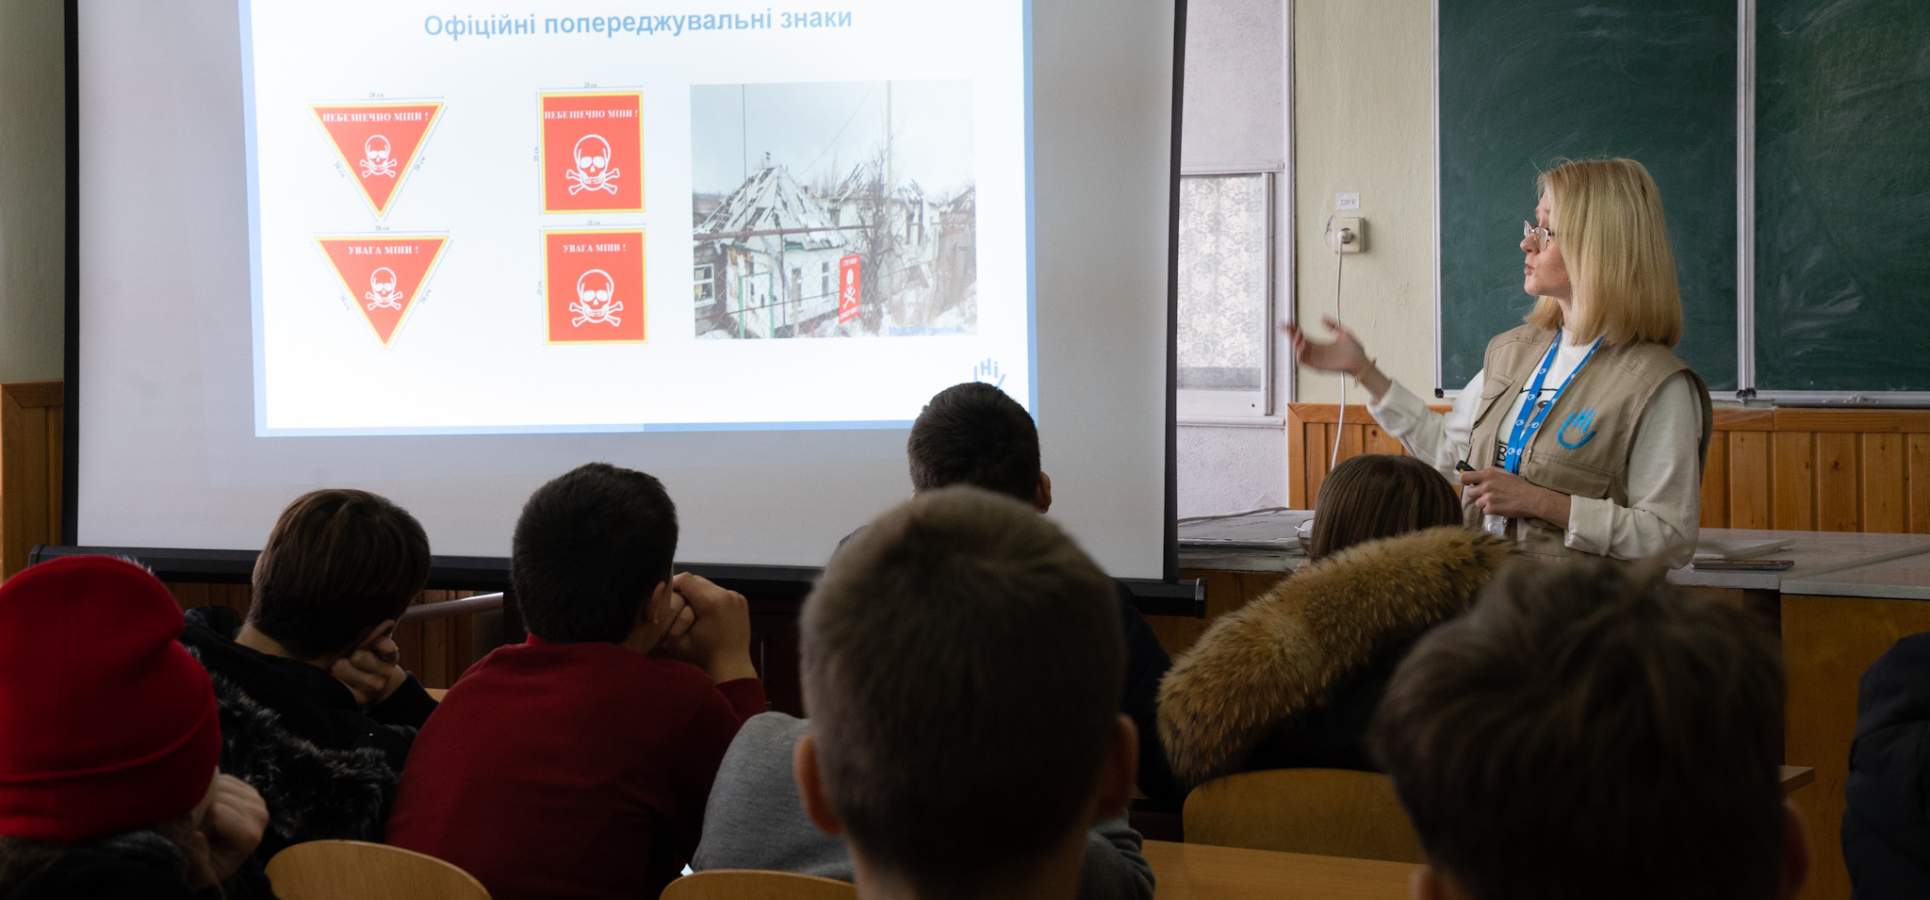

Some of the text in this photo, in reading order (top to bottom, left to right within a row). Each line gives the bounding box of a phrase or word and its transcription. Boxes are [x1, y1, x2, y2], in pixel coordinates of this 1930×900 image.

[424, 8, 853, 42] Офіційні попереджувальні знаки
